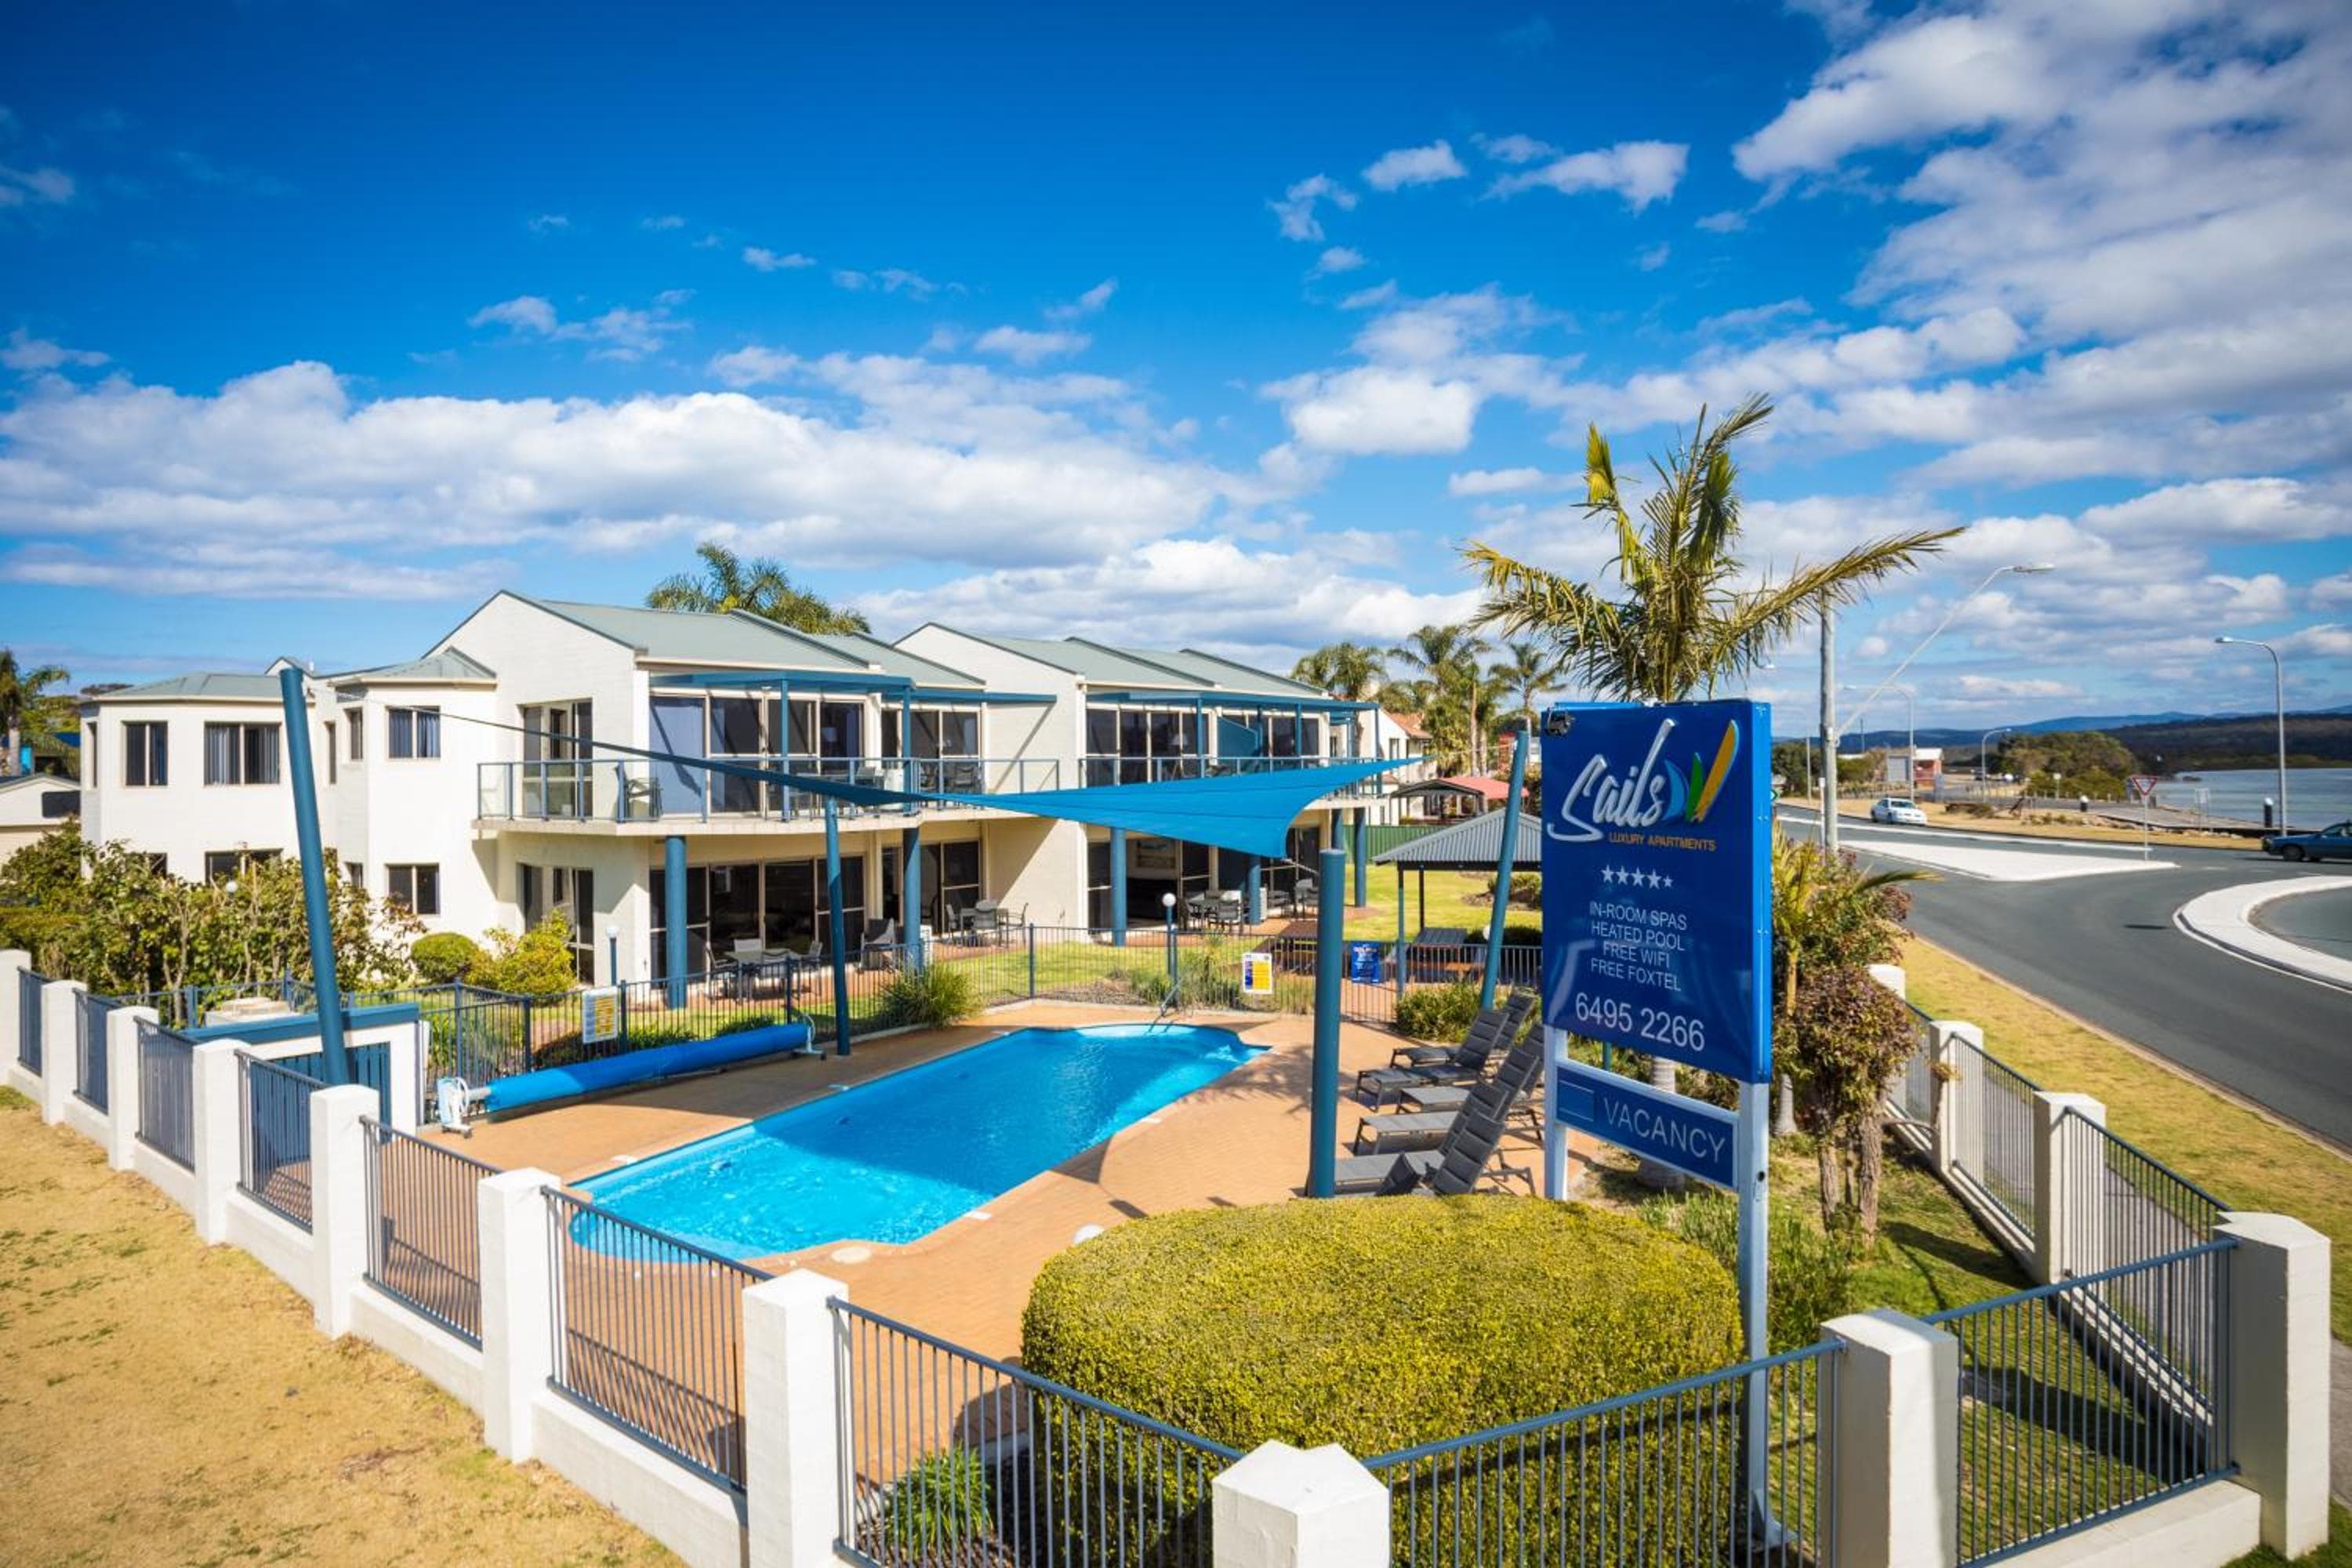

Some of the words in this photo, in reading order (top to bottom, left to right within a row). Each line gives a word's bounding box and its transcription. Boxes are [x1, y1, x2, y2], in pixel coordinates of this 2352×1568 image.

[1547, 718, 1675, 842] Sails
[1610, 832, 1644, 845] LUXURY
[1648, 834, 1717, 852] APARTMENTS
[1589, 901, 1646, 924] IN-ROOM
[1650, 909, 1687, 931] SPAS
[1592, 920, 1642, 943] HEATED
[1646, 930, 1686, 951] POOL
[1603, 941, 1637, 963] FREE
[1640, 949, 1670, 968] WIFI
[1591, 958, 1624, 979] FREE
[1628, 967, 1682, 992] FOXTEL
[1576, 992, 1633, 1033] 6495
[1640, 1007, 1705, 1051] 2266
[1603, 1098, 1725, 1164] VACANCY
